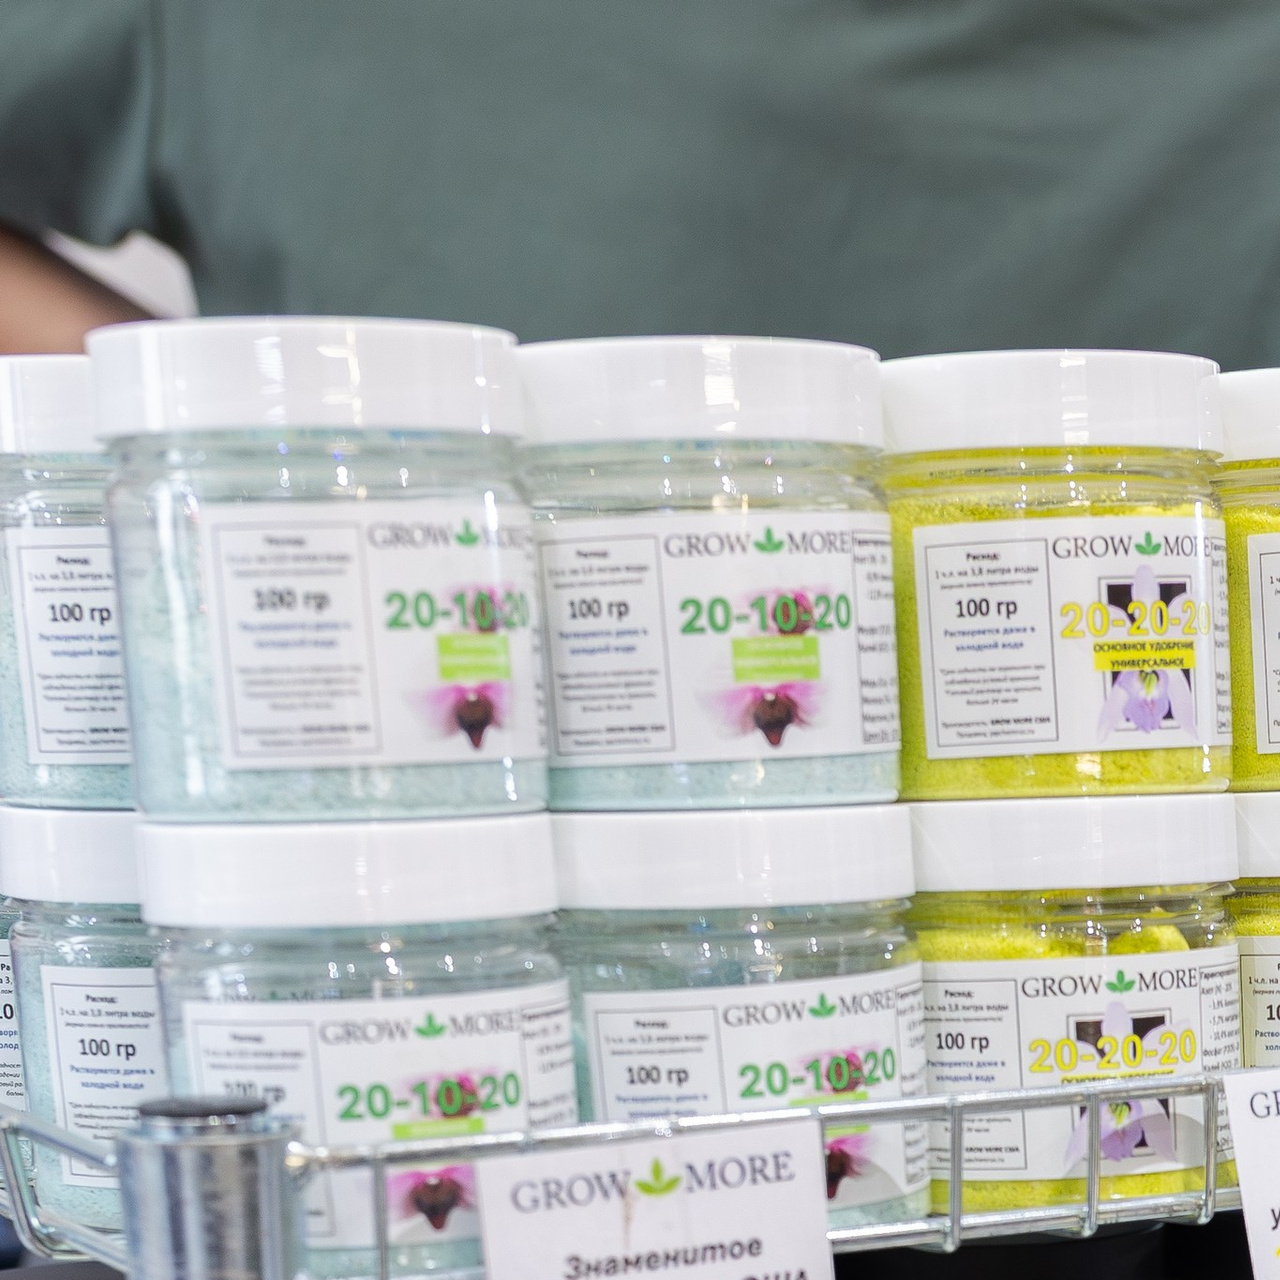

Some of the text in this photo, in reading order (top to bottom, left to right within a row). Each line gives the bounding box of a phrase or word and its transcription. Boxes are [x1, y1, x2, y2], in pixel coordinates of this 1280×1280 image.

[680, 594, 852, 636] 20-10-20
[338, 1072, 521, 1121] 20-10-20
[510, 1151, 796, 1213] GROW MORE
